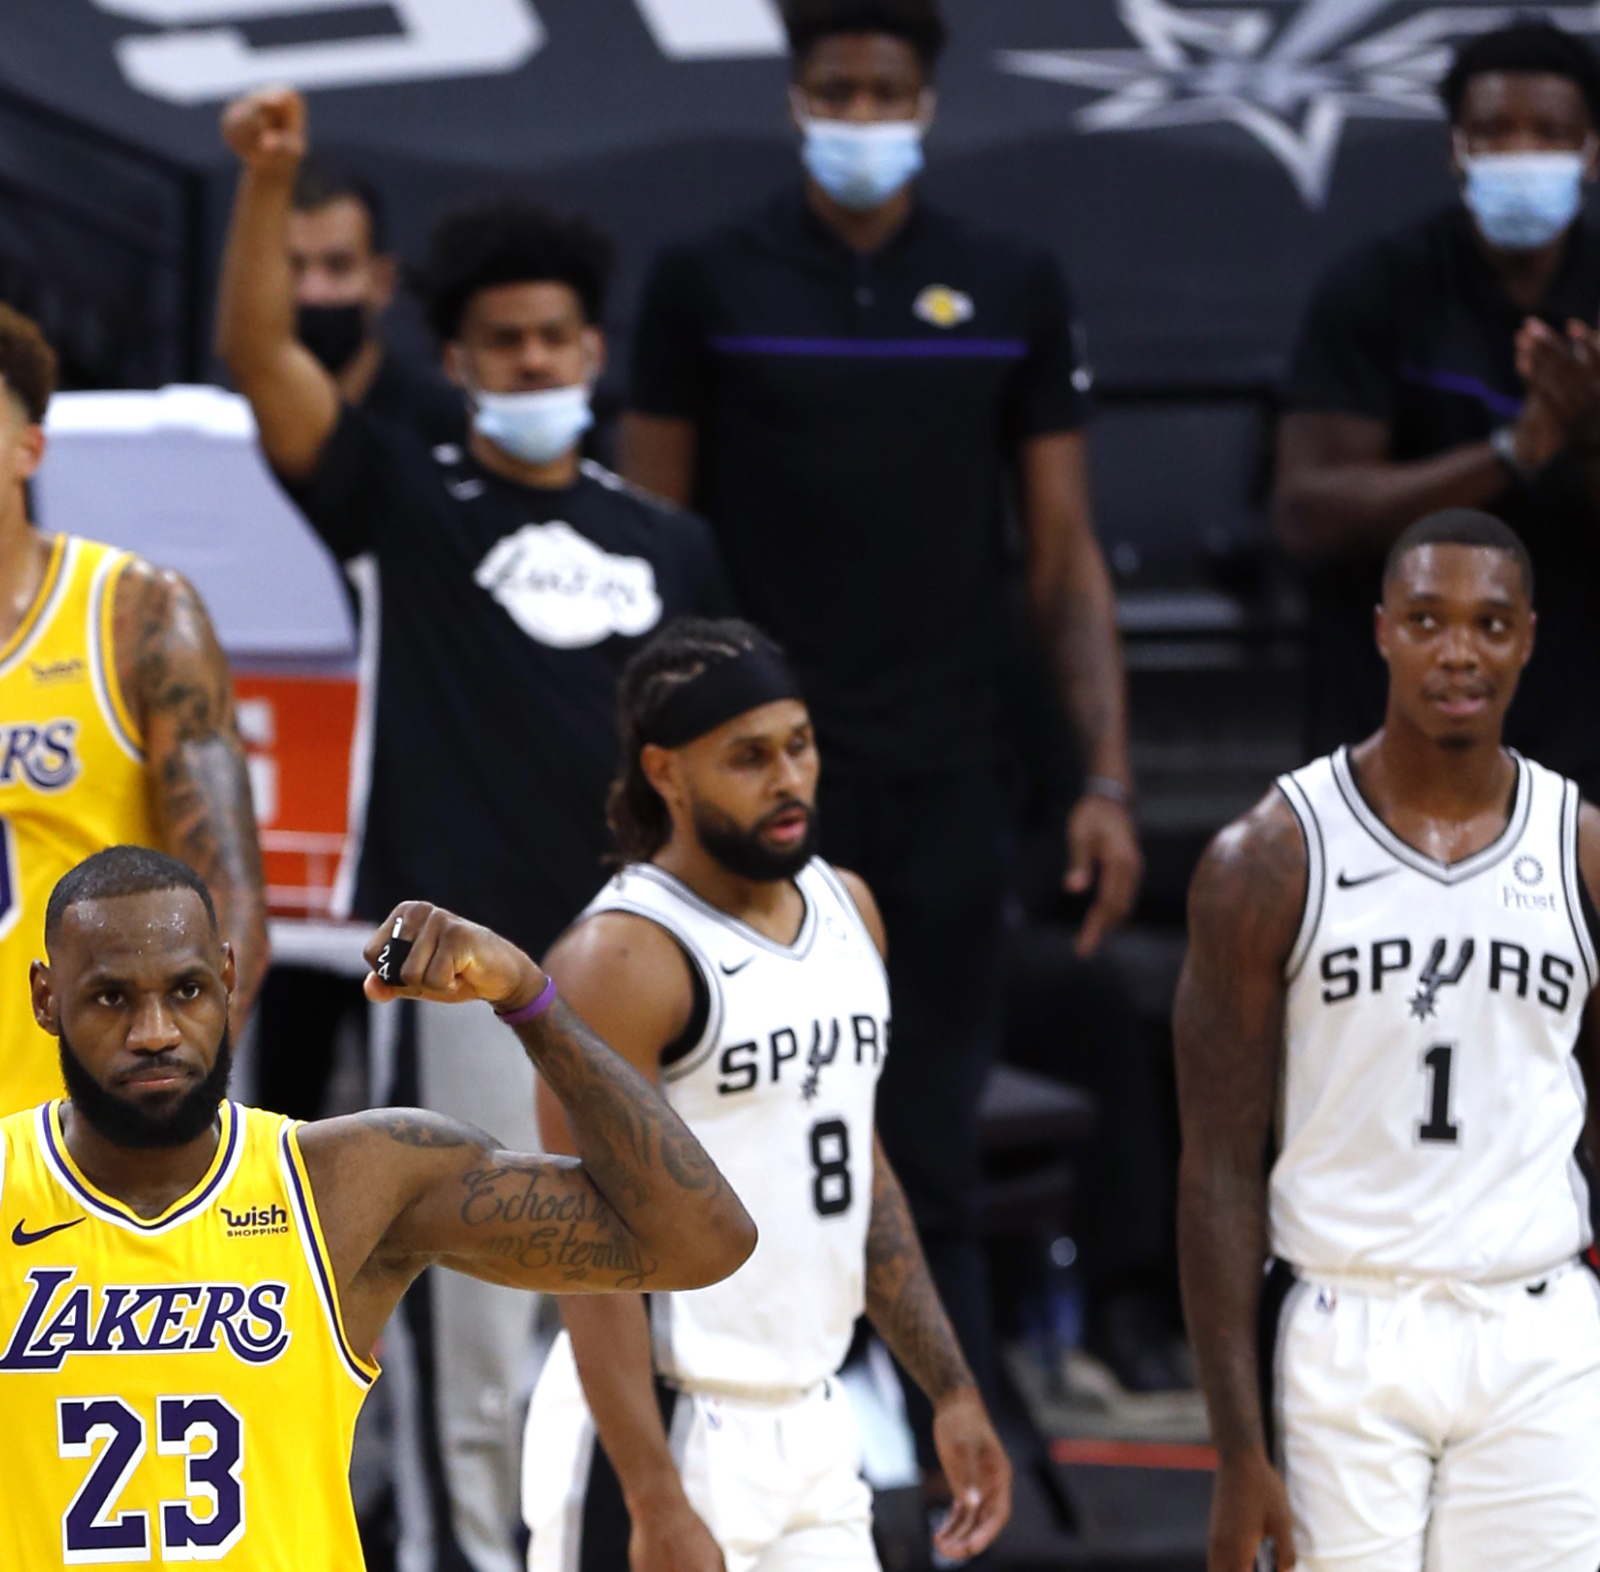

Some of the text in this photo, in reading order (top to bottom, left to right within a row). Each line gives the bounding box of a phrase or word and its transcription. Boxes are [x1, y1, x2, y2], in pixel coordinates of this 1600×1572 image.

[1320, 936, 1574, 1023] SPURS
[1414, 1041, 1462, 1149] 1
[808, 1115, 853, 1218] 8
[219, 1203, 288, 1227] wish
[226, 1226, 289, 1237] SHOPPING
[57, 1394, 246, 1565] 23
